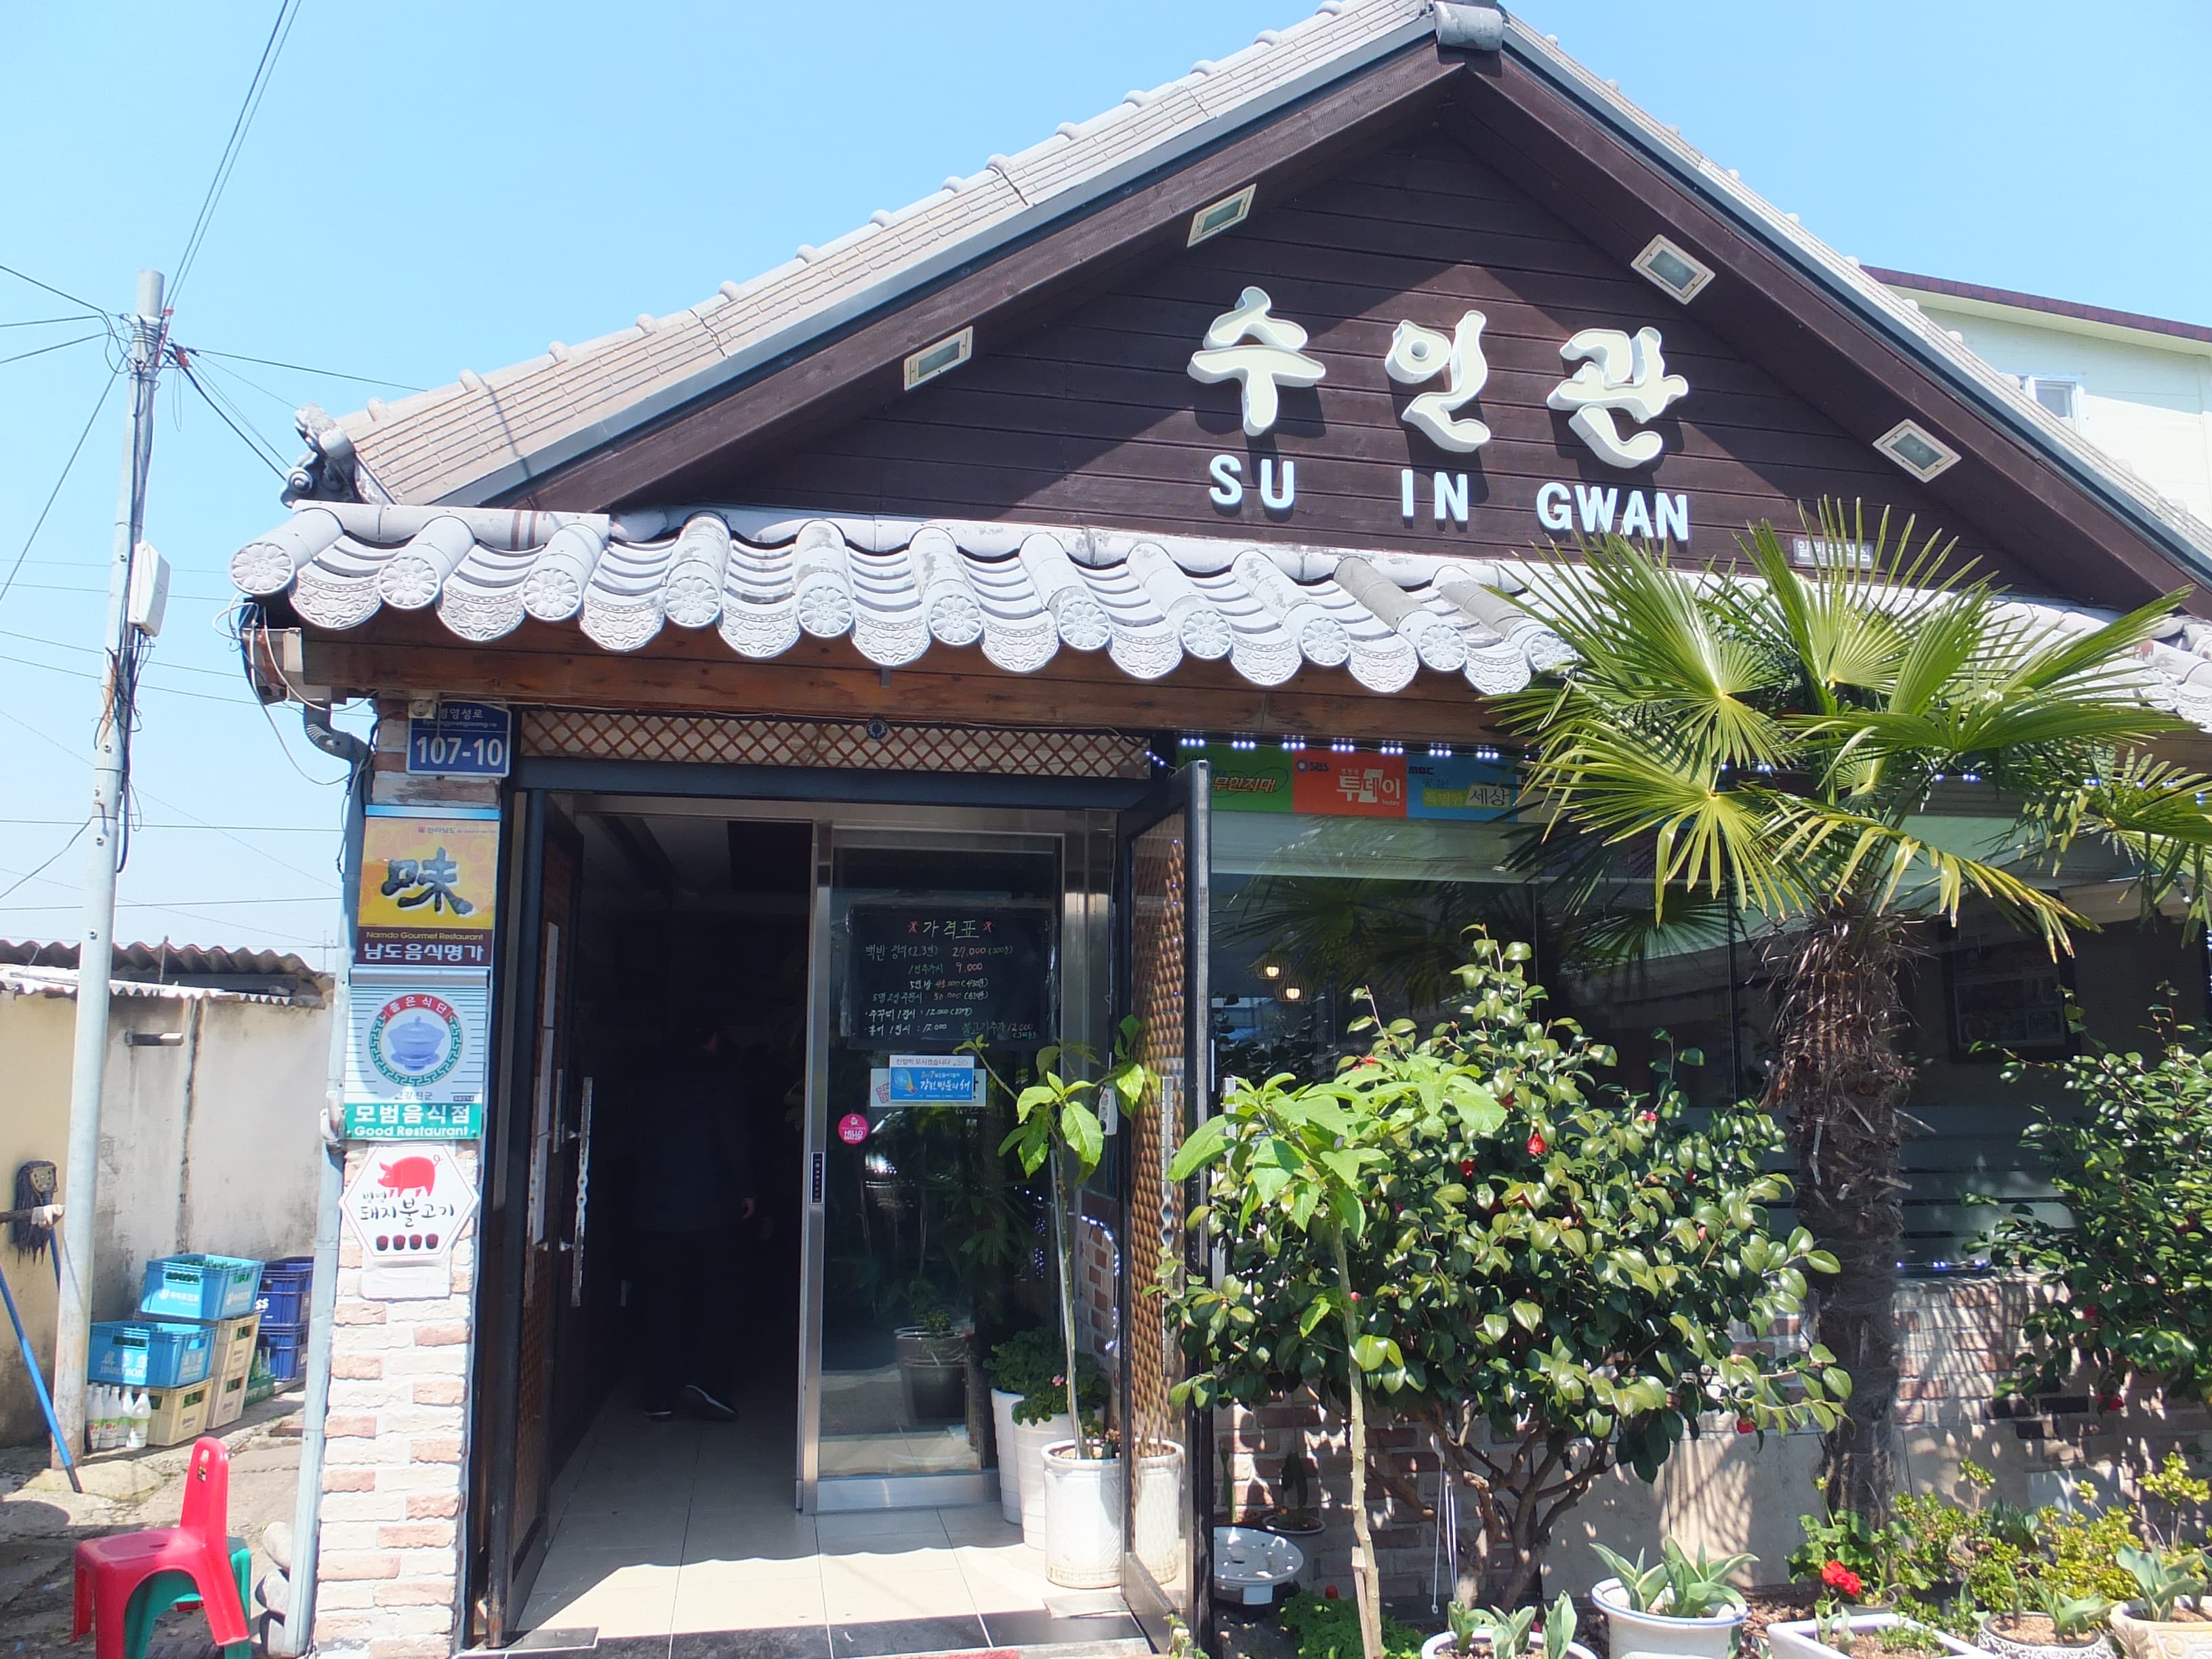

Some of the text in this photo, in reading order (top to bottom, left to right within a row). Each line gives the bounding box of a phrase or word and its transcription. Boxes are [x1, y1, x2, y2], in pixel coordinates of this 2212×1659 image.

[1187, 286, 1689, 468] 수인관
[1208, 454, 1689, 541] SU IN GWAN
[416, 736, 503, 766] 107-10
[1309, 762, 1329, 771] SBS
[1336, 769, 1400, 803] 투데이
[1469, 788, 1509, 806] 세상
[381, 846, 474, 916] 味
[439, 933, 483, 941] Restaurant
[922, 920, 977, 940] 가격표
[364, 943, 484, 962] 남도음식명가
[354, 1104, 470, 1124] 모범음식점
[354, 1126, 469, 1136] Good Restaurant
[360, 1198, 455, 1227] 돼지불고기
